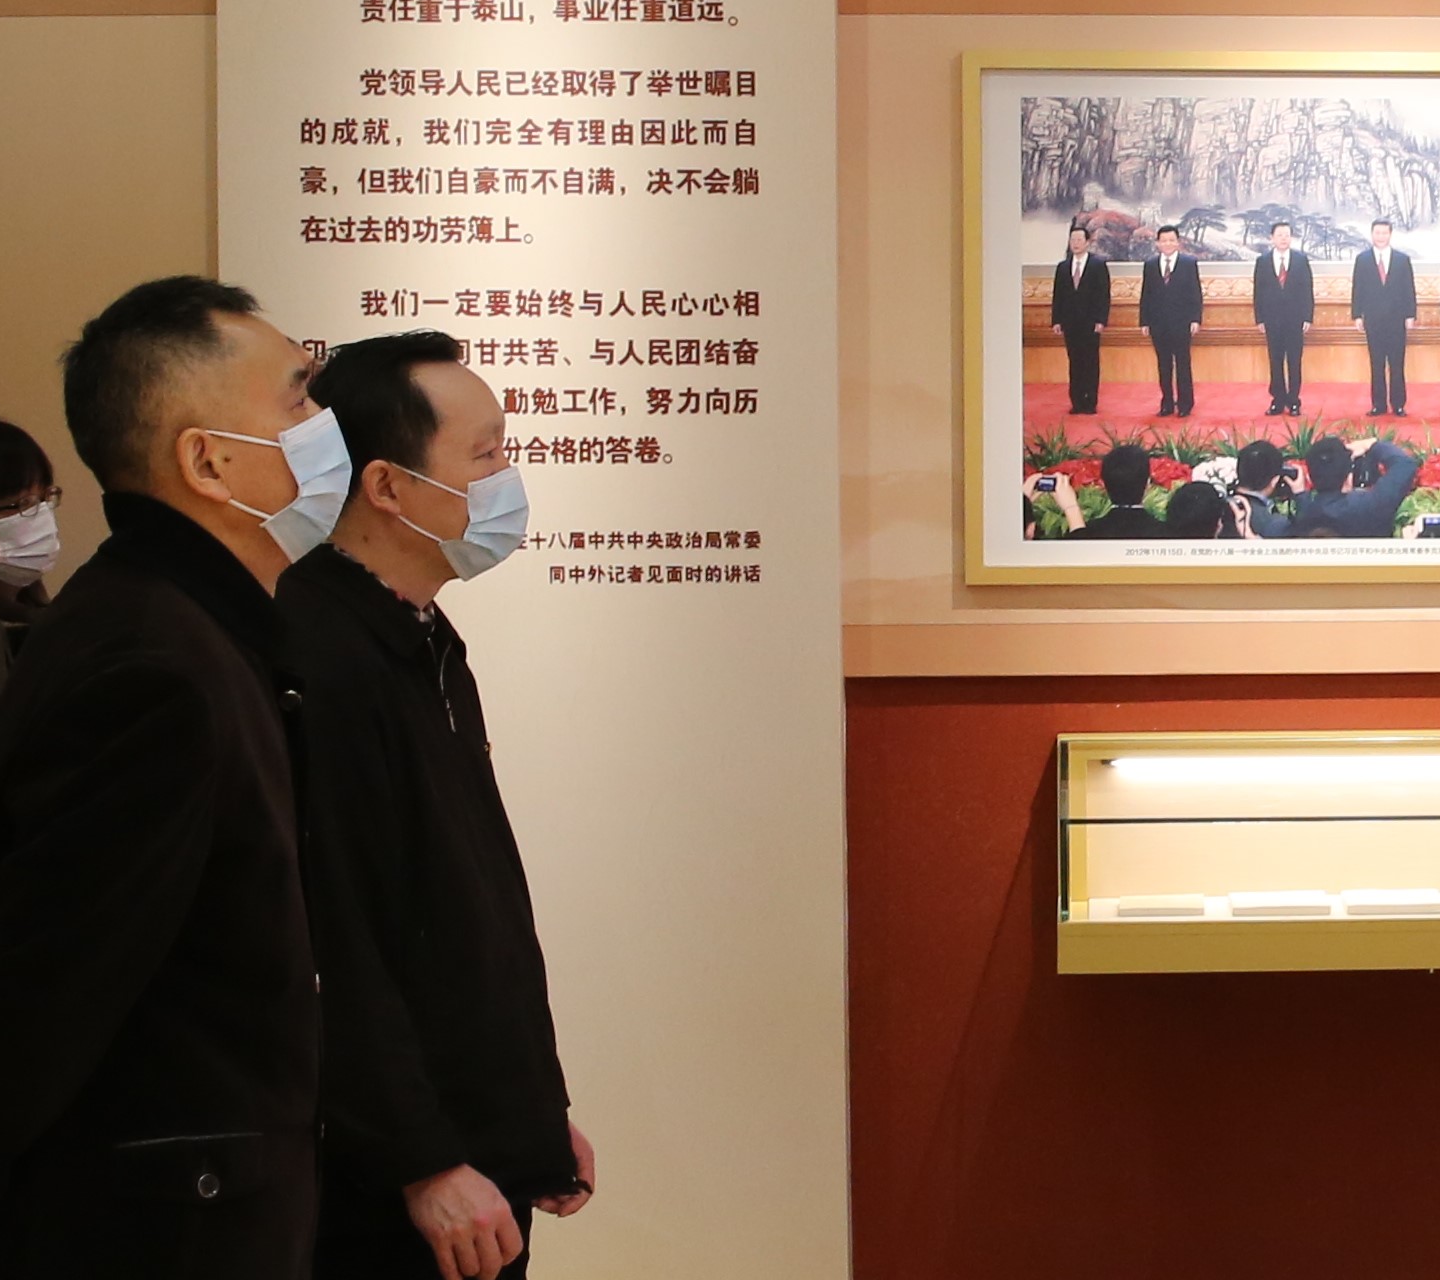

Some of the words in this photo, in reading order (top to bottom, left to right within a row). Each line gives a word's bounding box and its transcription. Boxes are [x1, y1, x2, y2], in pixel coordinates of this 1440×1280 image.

[359, 68, 757, 98] 党领导人民已经取得了举世瞩目
[300, 117, 757, 147] 的成就，我们完全有理由因此而自
[300, 166, 760, 196] 豪，但我们自豪而不自满，决不会躺
[300, 215, 535, 245] 在过去的功劳簿上。
[360, 288, 761, 318] 我们一定要始终与人民心心相
[503, 386, 760, 417] 勤勉工作，努力向历
[548, 564, 762, 584] 同中外记者见面时的讲话
